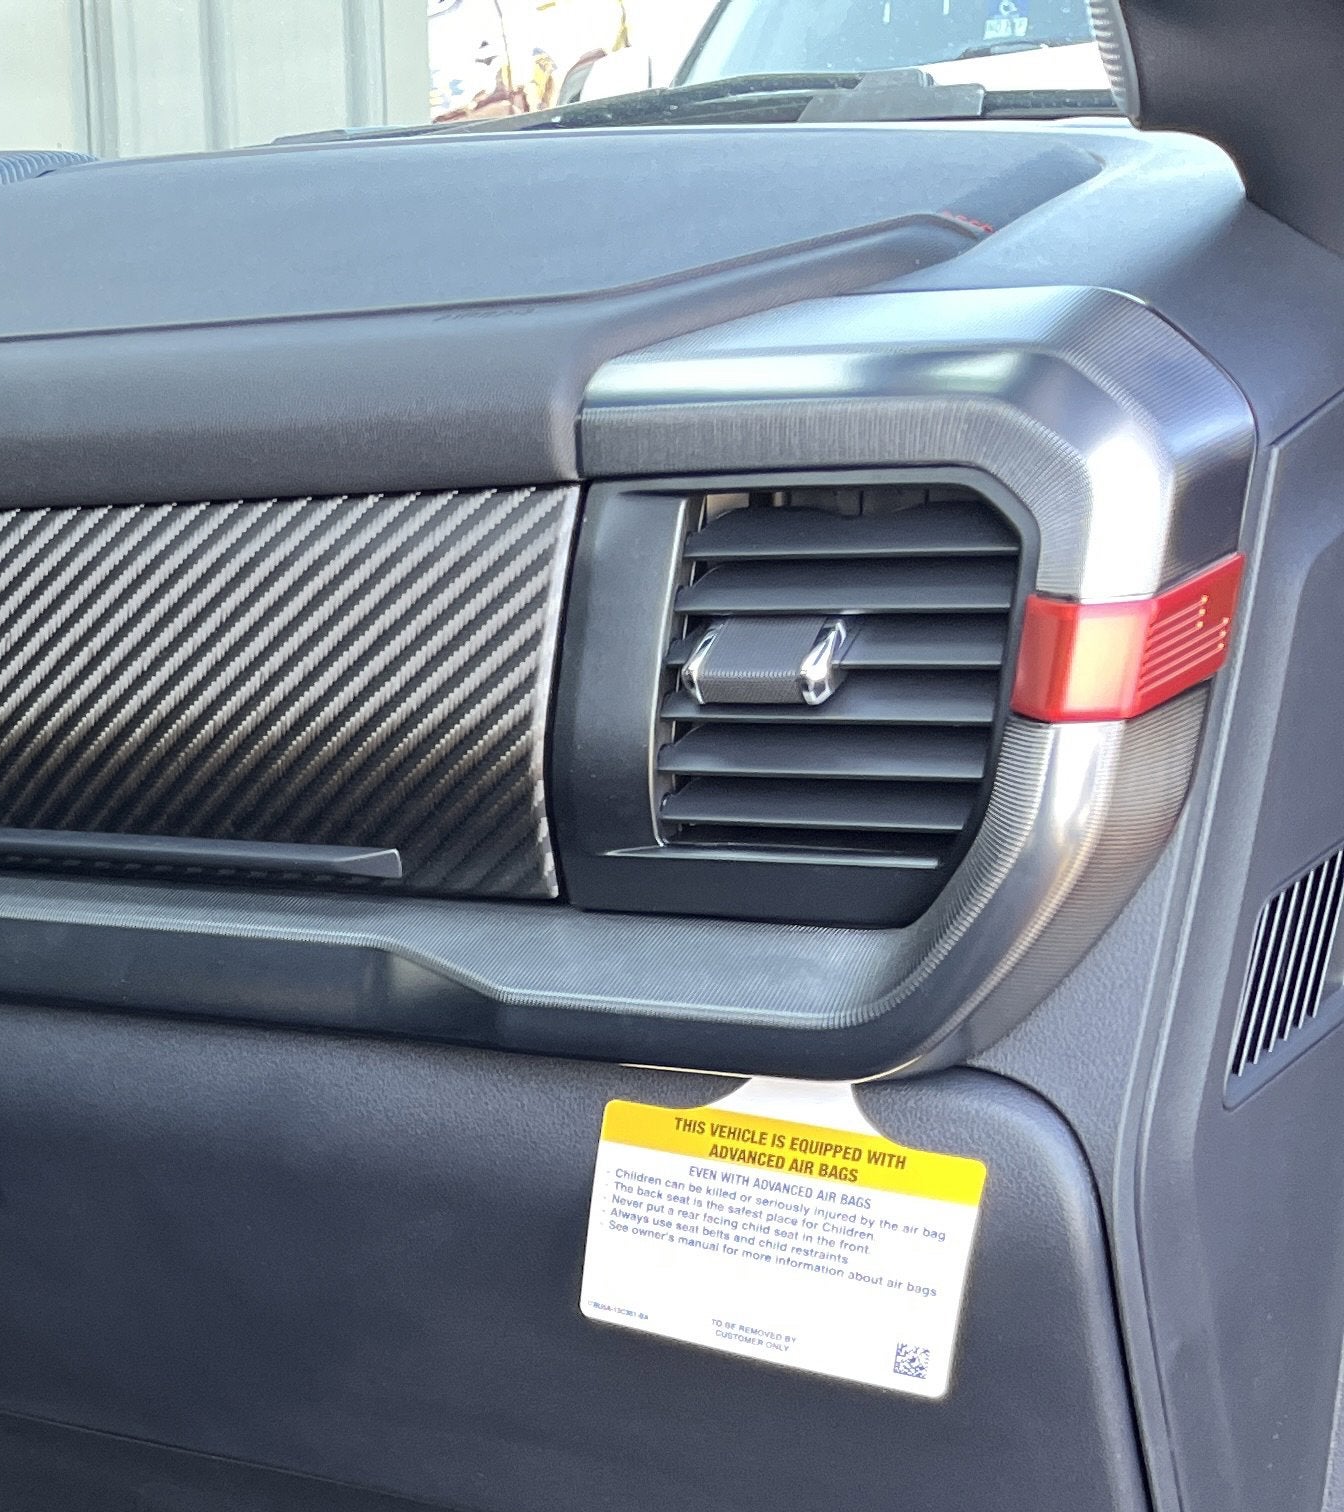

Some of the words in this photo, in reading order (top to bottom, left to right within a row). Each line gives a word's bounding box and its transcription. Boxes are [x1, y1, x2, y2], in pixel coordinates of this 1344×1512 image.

[674, 1116, 706, 1135] THIS
[709, 1122, 769, 1147] VEHICLE
[771, 1133, 786, 1149] IS
[789, 1136, 863, 1163] EQUIPPED
[867, 1149, 907, 1170] WITH
[708, 1143, 786, 1170] ADVANCED
[788, 1157, 814, 1176] AIR
[818, 1163, 859, 1184] BAGS
[614, 1181, 634, 1194] The
[636, 1186, 667, 1200] back
[666, 1192, 690, 1205] seat
[693, 1196, 703, 1207] is
[706, 1199, 725, 1212] the
[727, 1204, 763, 1219] safest
[765, 1211, 798, 1227] place
[801, 1217, 819, 1230] for
[615, 1168, 662, 1186] Children
[664, 1179, 685, 1191] can
[688, 1182, 703, 1195] be
[705, 1186, 737, 1201] killed
[739, 1192, 753, 1203] or
[755, 1197, 811, 1216] seriously
[813, 1206, 857, 1224] injured
[859, 1214, 875, 1229] by
[879, 1219, 899, 1231] the
[902, 1224, 919, 1235] air
[922, 1226, 946, 1242] bag
[688, 1165, 717, 1181] EVEN
[721, 1171, 750, 1187] WITH
[752, 1177, 813, 1198] ADVANCED
[816, 1189, 837, 1203] AIR
[839, 1193, 872, 1211] BAGS
[610, 1207, 649, 1225] Always
[652, 1218, 673, 1229] use
[675, 1222, 699, 1234] seat
[702, 1225, 730, 1241] belts
[733, 1233, 756, 1246] and
[758, 1237, 788, 1252] child
[790, 1245, 849, 1265] restraints
[612, 1194, 644, 1209] Never
[646, 1202, 665, 1215] put
[667, 1207, 675, 1216] a
[677, 1208, 700, 1221] rear
[702, 1212, 739, 1231] facing
[741, 1220, 771, 1235] child
[774, 1227, 799, 1241] seat
[802, 1231, 813, 1242] in
[816, 1235, 836, 1248] the
[608, 1219, 629, 1233] See
[631, 1226, 675, 1243] owner's
[678, 1235, 719, 1252] manual
[722, 1243, 739, 1256] for
[741, 1249, 772, 1262] more
[775, 1255, 845, 1278] information
[847, 1272, 884, 1286] about
[886, 1279, 903, 1290] air
[906, 1281, 937, 1298] bags
[712, 1318, 723, 1328] TO
[724, 1320, 736, 1331] BE
[738, 1323, 782, 1342] REMOVED
[784, 1332, 797, 1344] BY
[715, 1329, 764, 1347] CUSTOMER
[765, 1340, 790, 1353] ONLY
